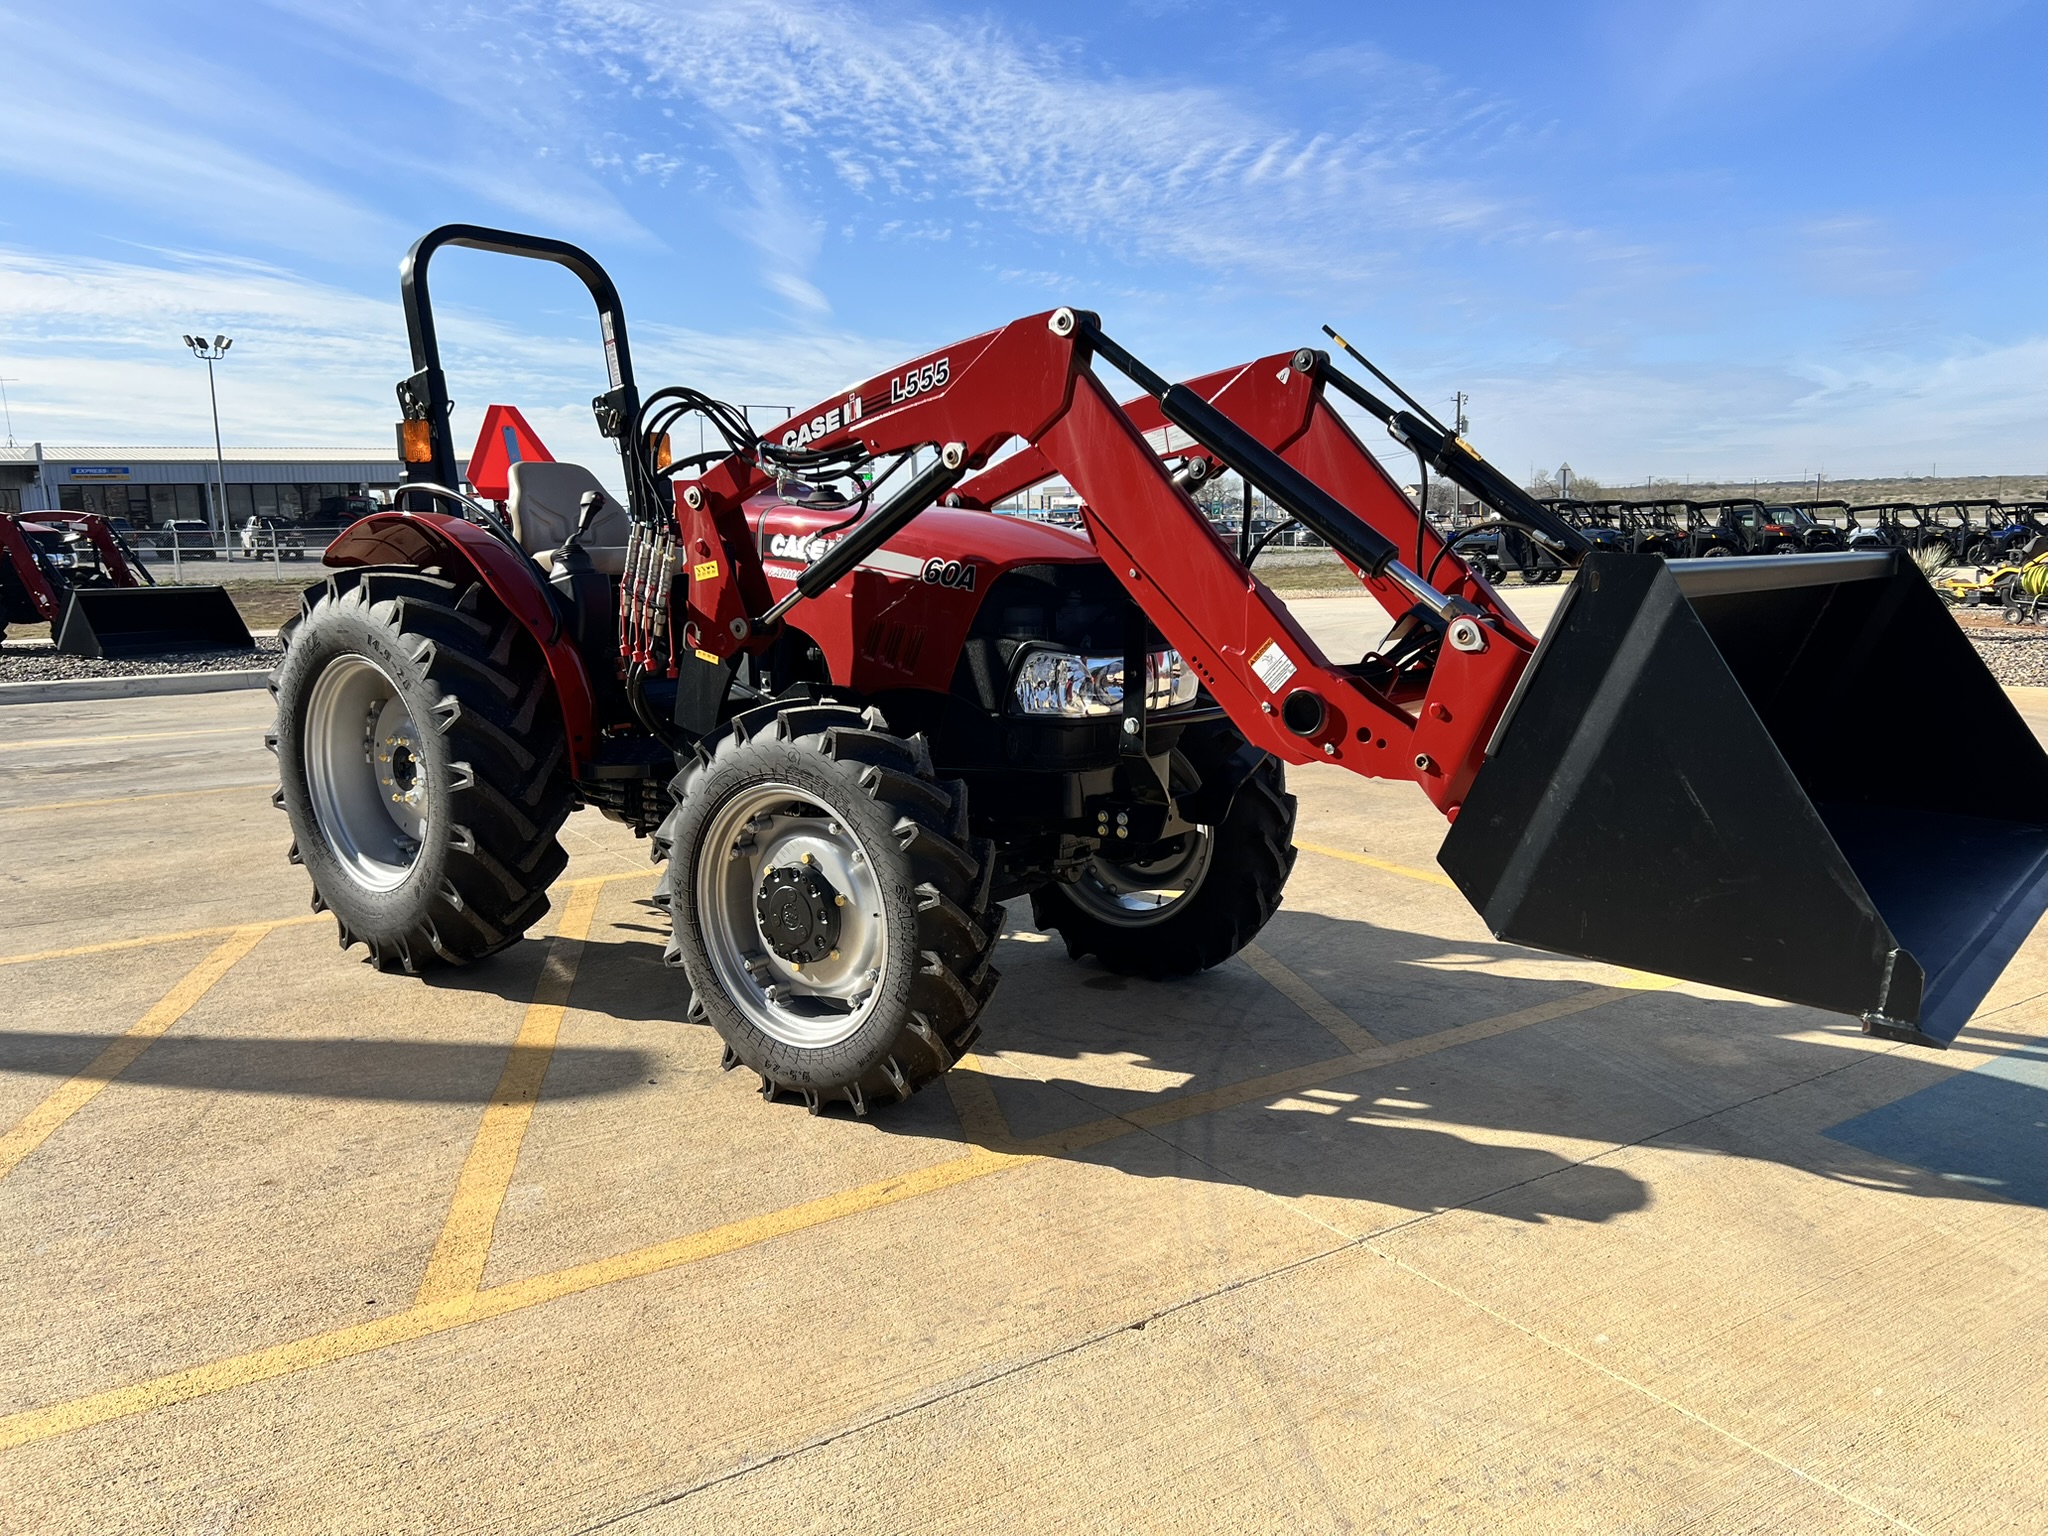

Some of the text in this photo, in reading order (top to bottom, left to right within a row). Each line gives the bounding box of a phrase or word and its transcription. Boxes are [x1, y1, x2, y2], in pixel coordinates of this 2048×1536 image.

[891, 357, 950, 404] L555
[782, 408, 840, 448] CASE
[923, 557, 977, 592] 60A
